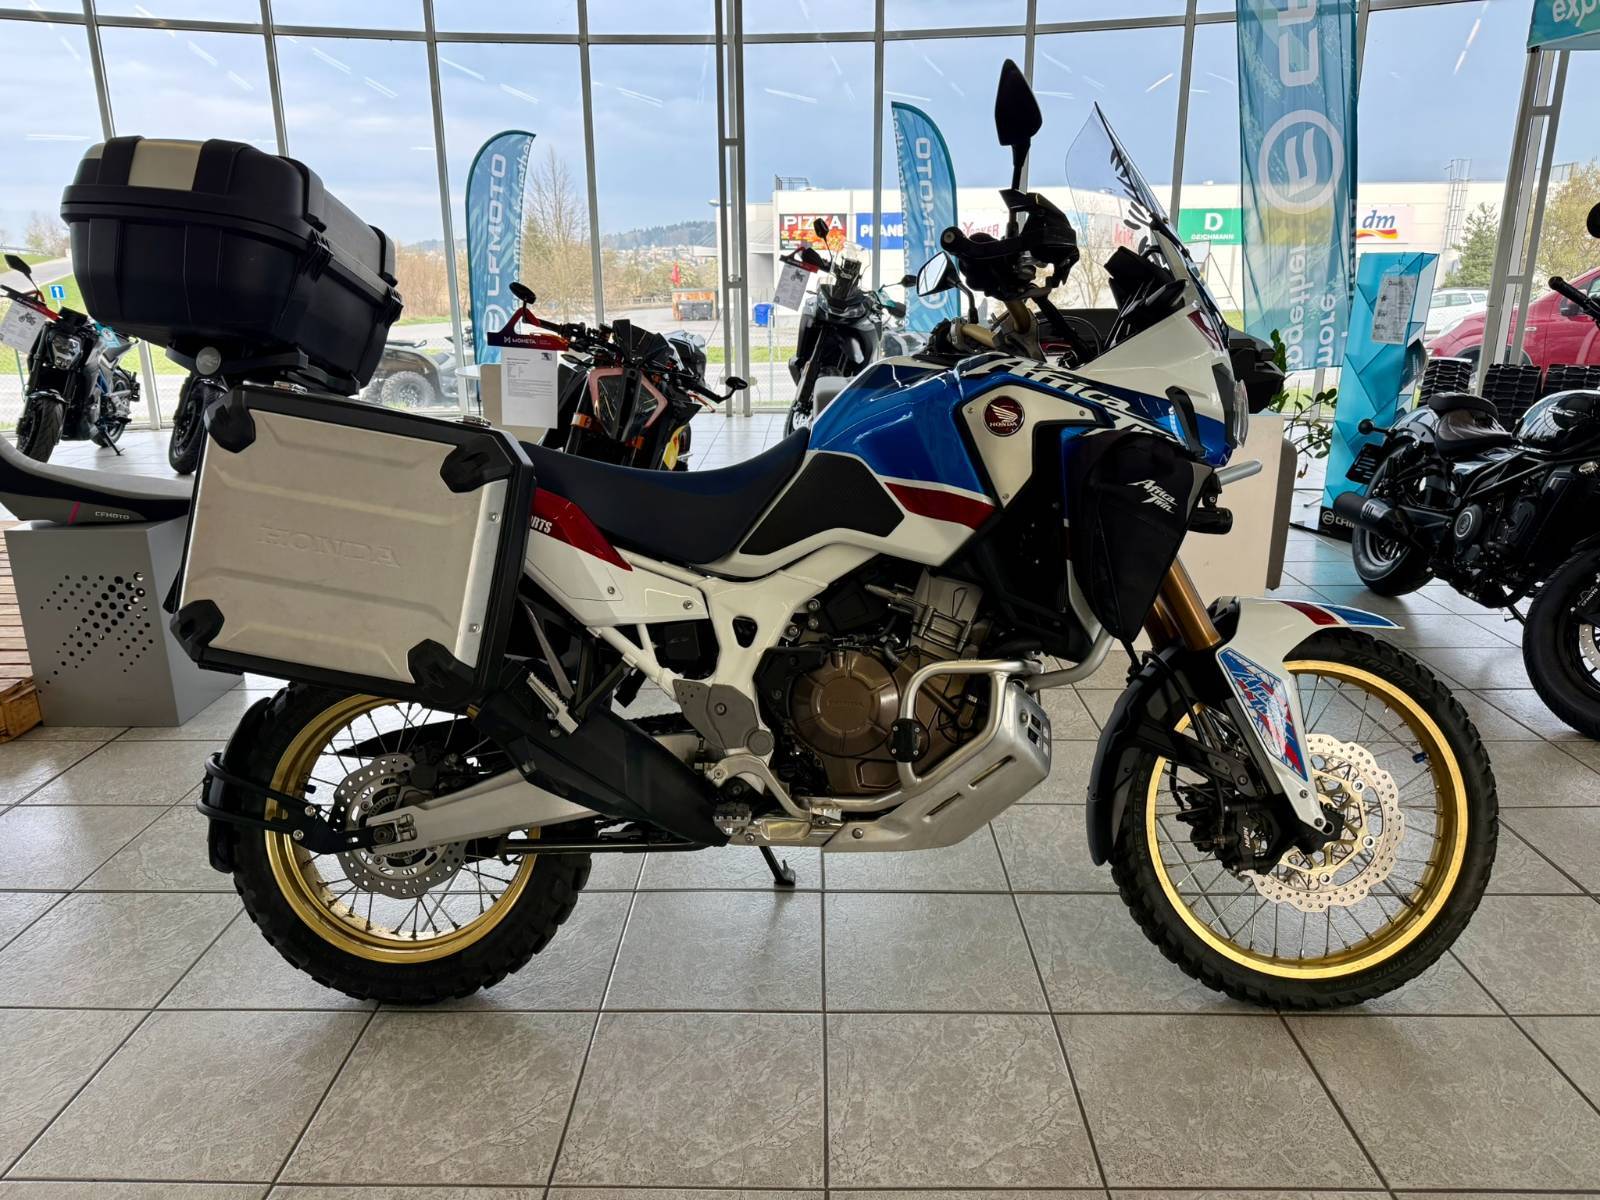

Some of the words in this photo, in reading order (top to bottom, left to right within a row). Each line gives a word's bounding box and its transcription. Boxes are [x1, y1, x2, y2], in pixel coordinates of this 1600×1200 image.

[1204, 212, 1223, 232] D
[1362, 209, 1396, 229] dm
[1126, 479, 1178, 506] Africa
[1141, 492, 1175, 514] Twin
[530, 514, 553, 534] RTS
[255, 524, 402, 568] HONDA
